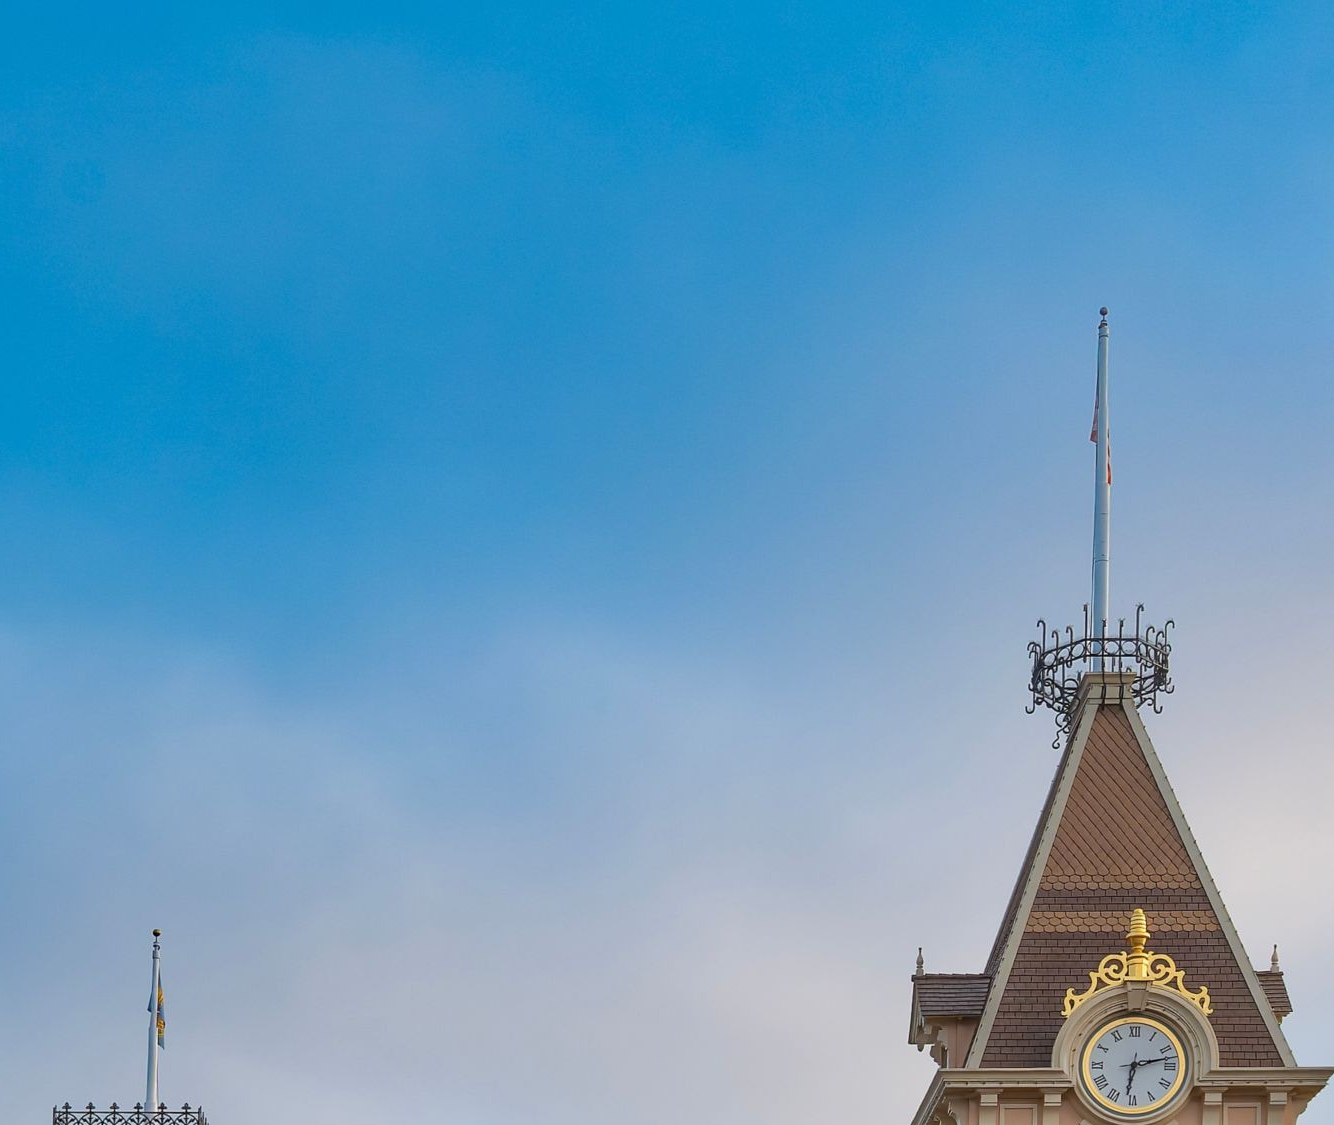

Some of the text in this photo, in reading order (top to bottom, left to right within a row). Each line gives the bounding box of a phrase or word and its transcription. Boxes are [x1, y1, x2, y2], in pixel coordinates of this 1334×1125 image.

[1111, 1030, 1123, 1042] XI
[1129, 1026, 1140, 1037] XII
[1097, 1044, 1109, 1053] X
[1160, 1045, 1172, 1054] II
[1091, 1061, 1104, 1070] IX
[1164, 1062, 1176, 1071] III
[1093, 1074, 1109, 1091] VIII
[1107, 1088, 1120, 1103] VII
[1128, 1095, 1137, 1106] VI
[1147, 1091, 1156, 1102] V
